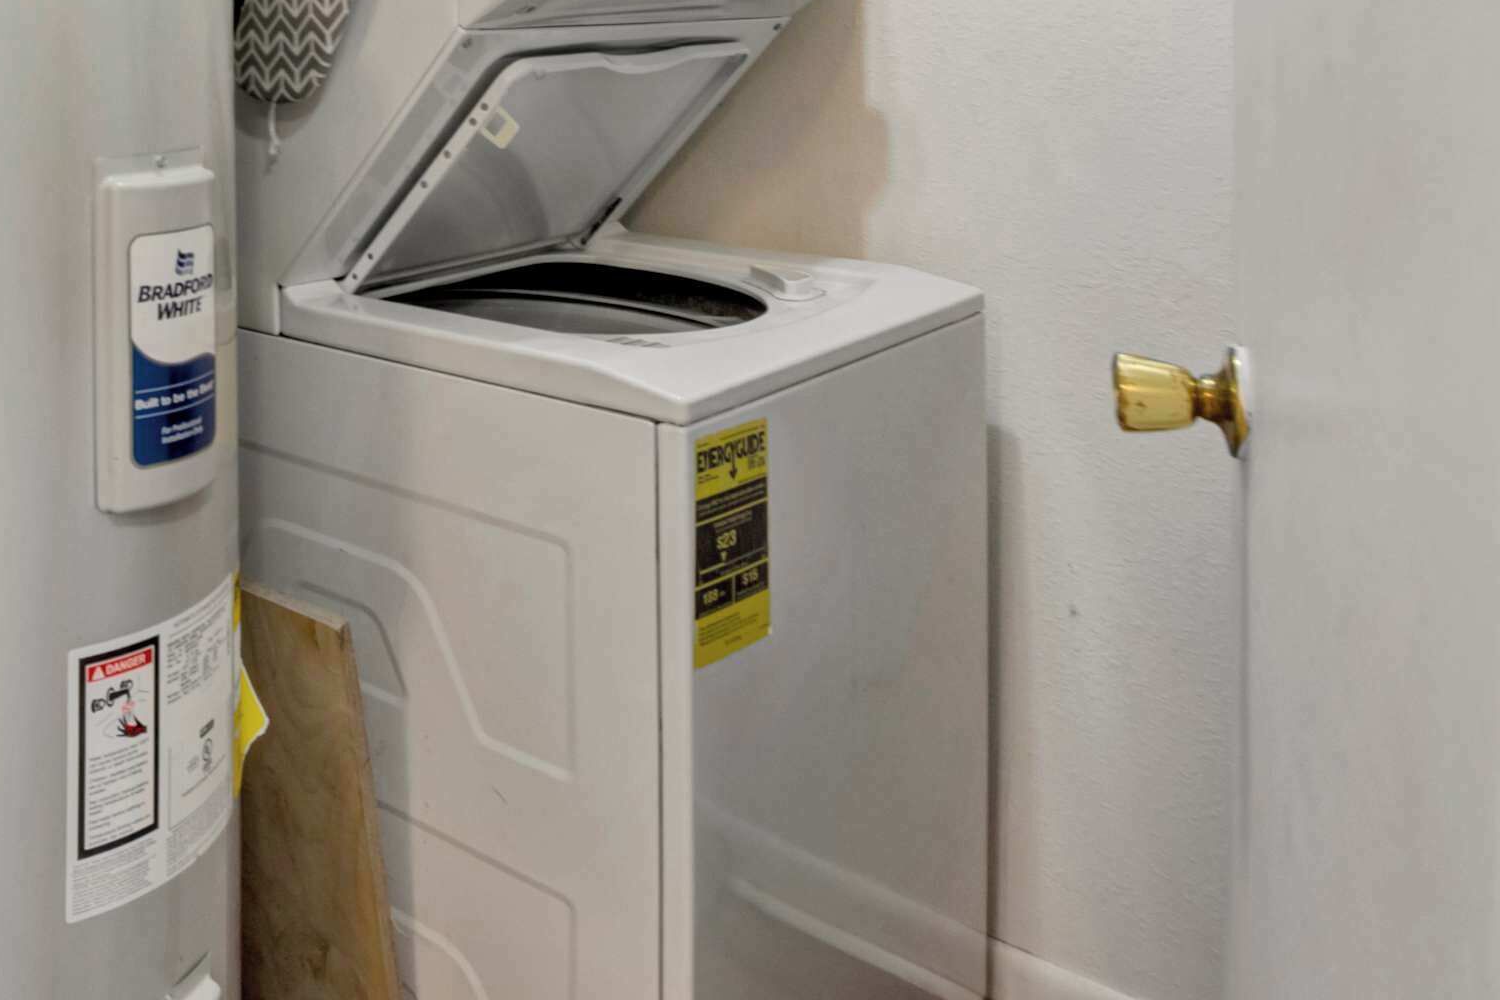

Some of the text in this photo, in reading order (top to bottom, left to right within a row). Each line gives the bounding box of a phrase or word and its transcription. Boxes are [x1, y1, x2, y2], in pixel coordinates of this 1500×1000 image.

[138, 273, 212, 303] BRADFORD
[158, 297, 201, 320] WHITE
[105, 653, 146, 676] DANGER
